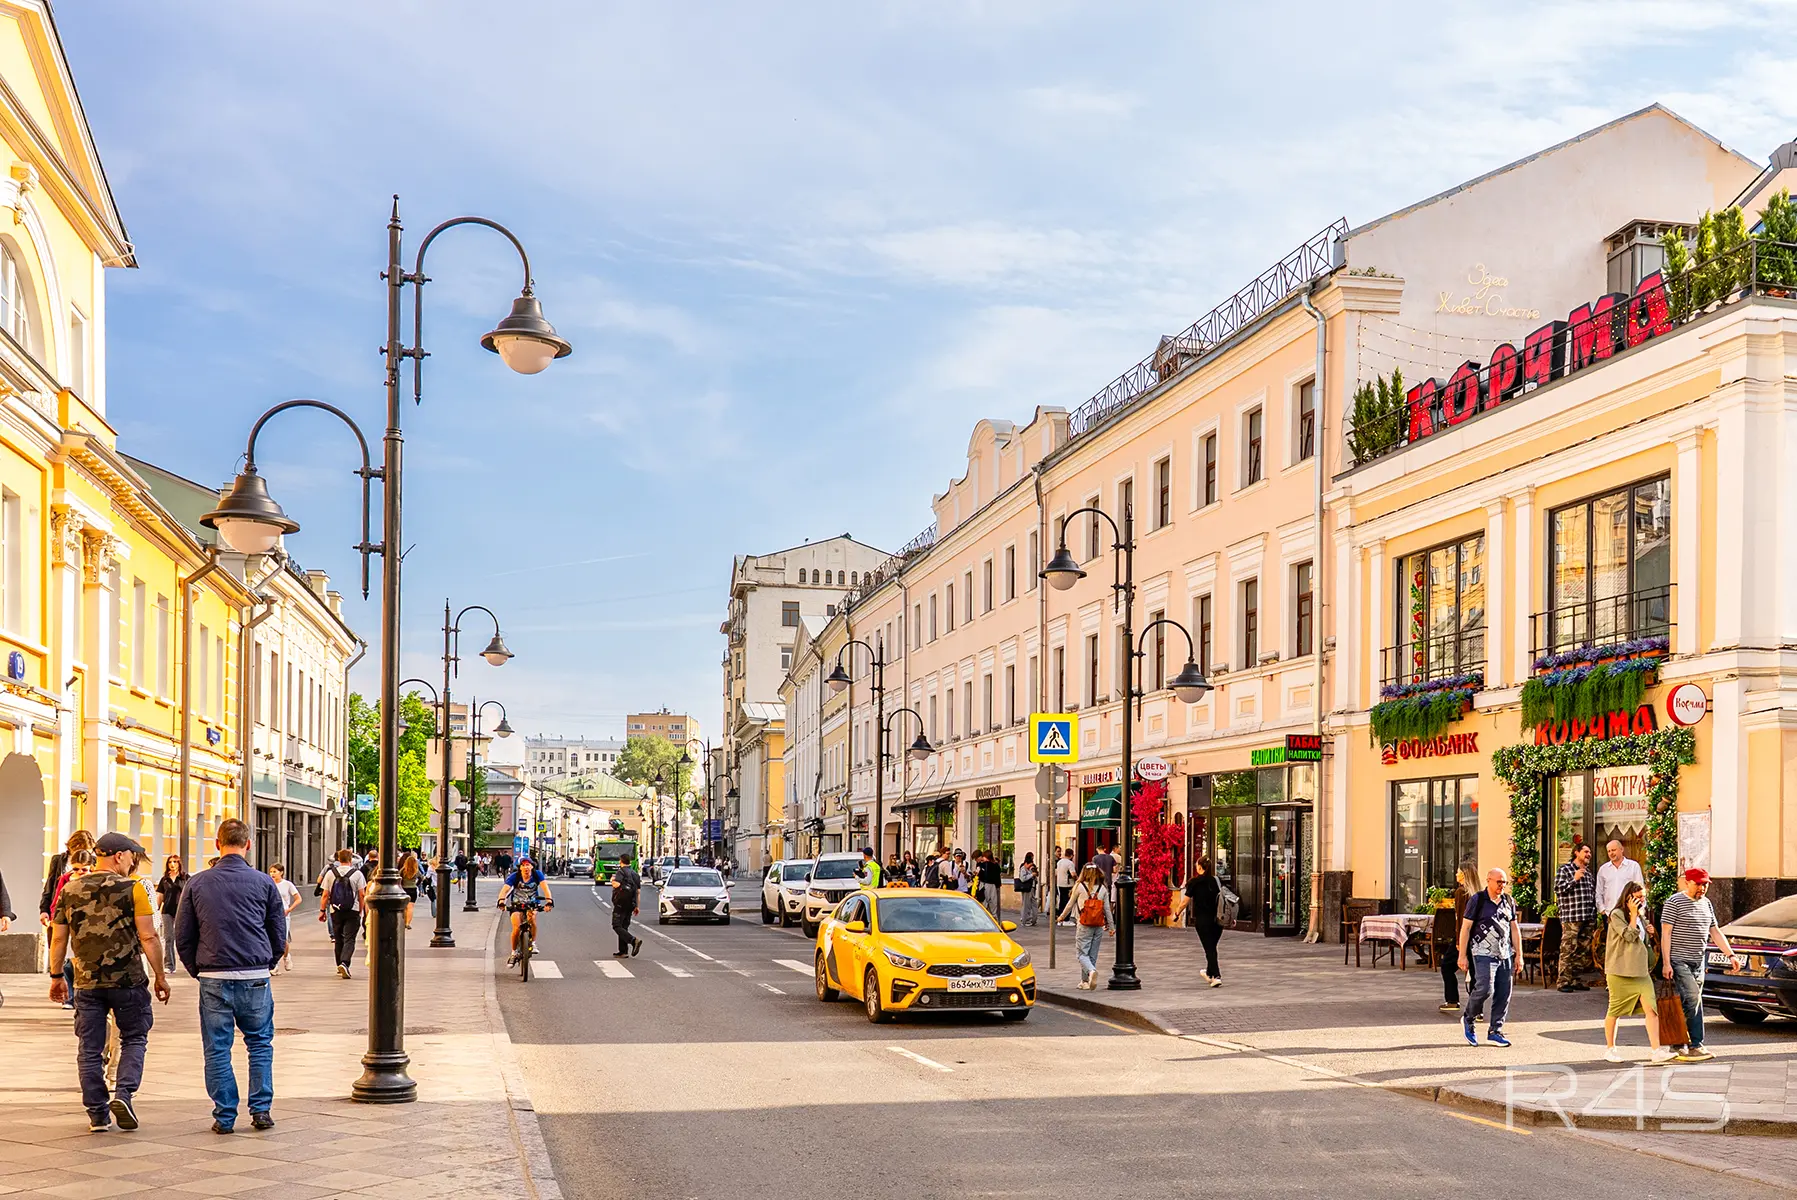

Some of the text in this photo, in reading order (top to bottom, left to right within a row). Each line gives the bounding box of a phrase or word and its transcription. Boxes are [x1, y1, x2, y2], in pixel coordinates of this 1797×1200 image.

[1485, 294, 1541, 319] Счастье
[1407, 269, 1672, 444] КОРЧМА
[1288, 735, 1321, 749] ТАБАК
[1251, 747, 1286, 766] НАПИТКИ
[1288, 750, 1321, 760] НАПИТКИ
[1140, 763, 1167, 771] ЦВЕТЫ
[1593, 775, 1648, 797] ЗАВТРА
